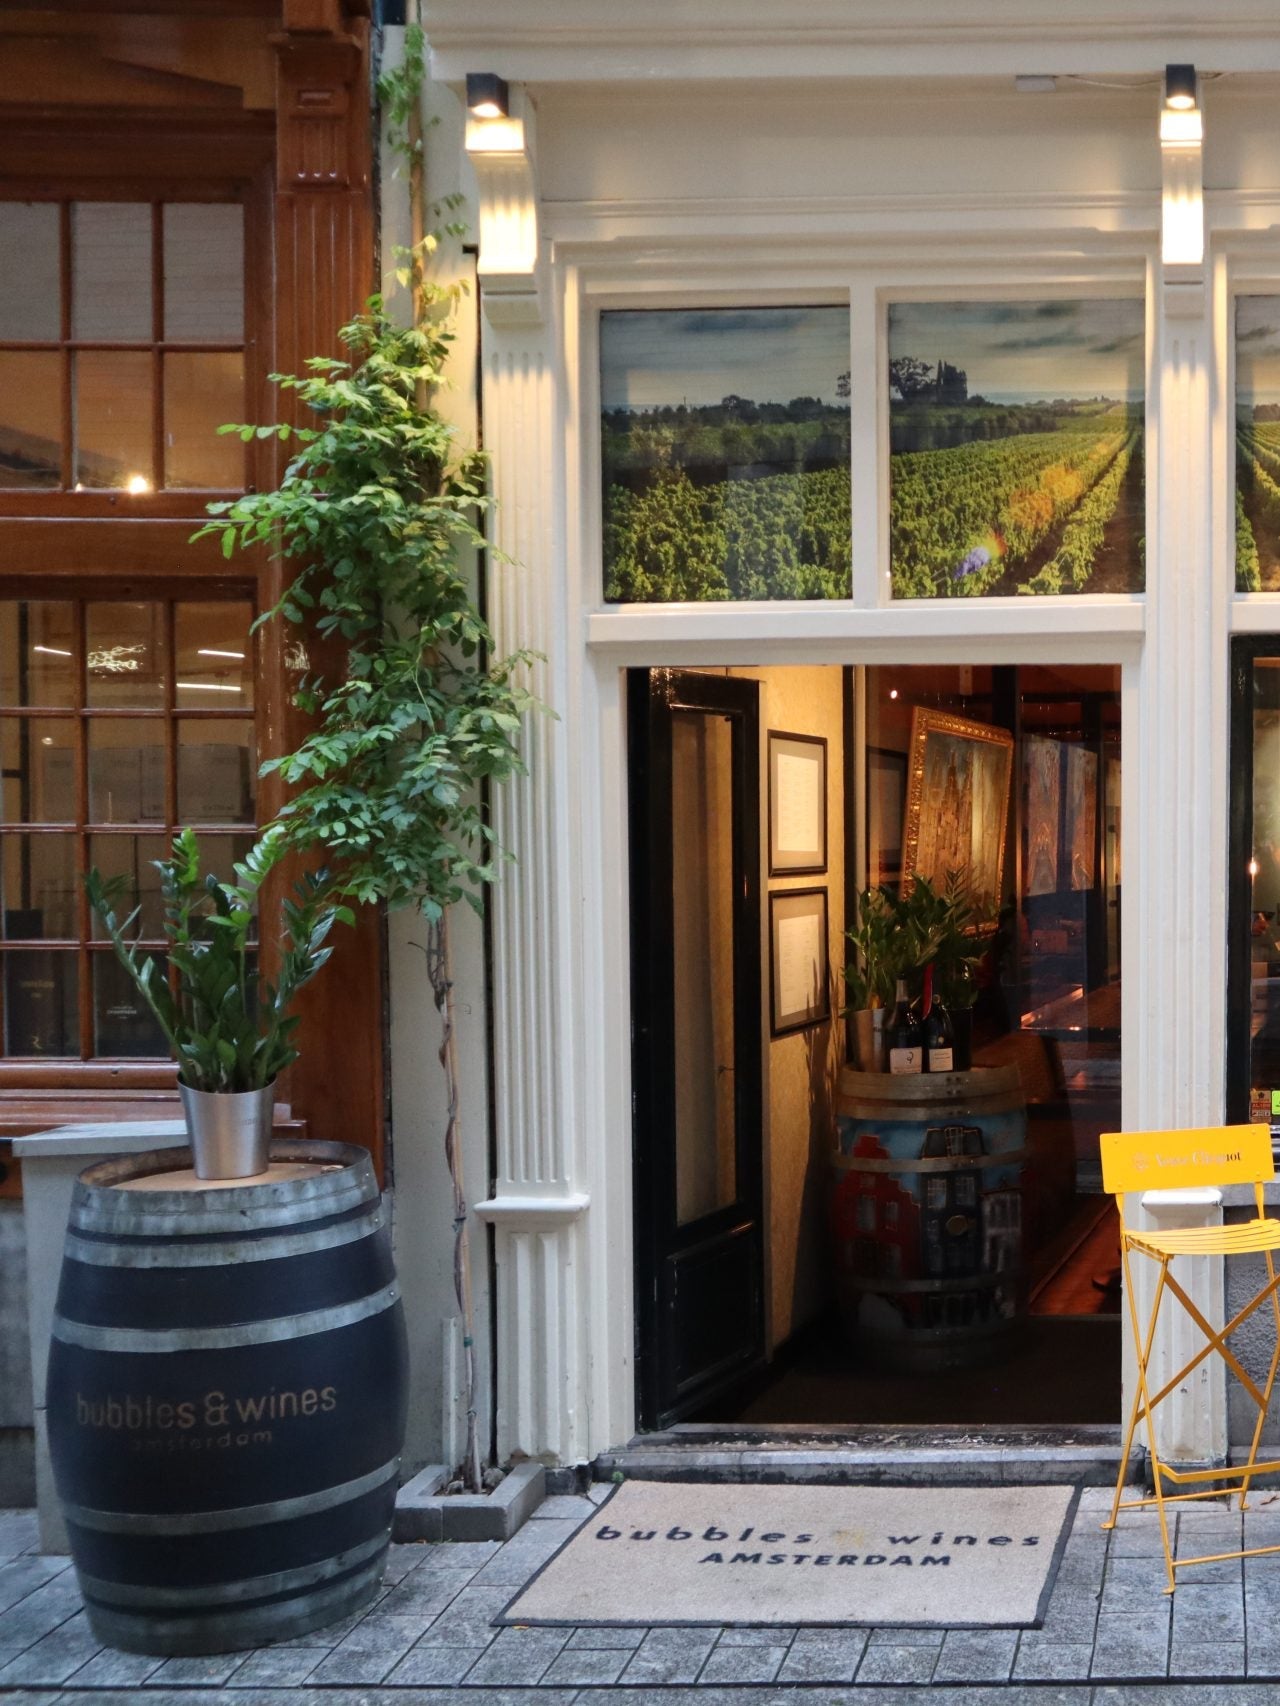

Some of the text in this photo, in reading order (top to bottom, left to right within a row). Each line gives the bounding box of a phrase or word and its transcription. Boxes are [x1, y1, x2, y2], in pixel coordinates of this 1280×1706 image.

[132, 1430, 273, 1453] amsterdam
[594, 1525, 1041, 1547] bubbles wines
[698, 1552, 952, 1567] AMSTERDAM
